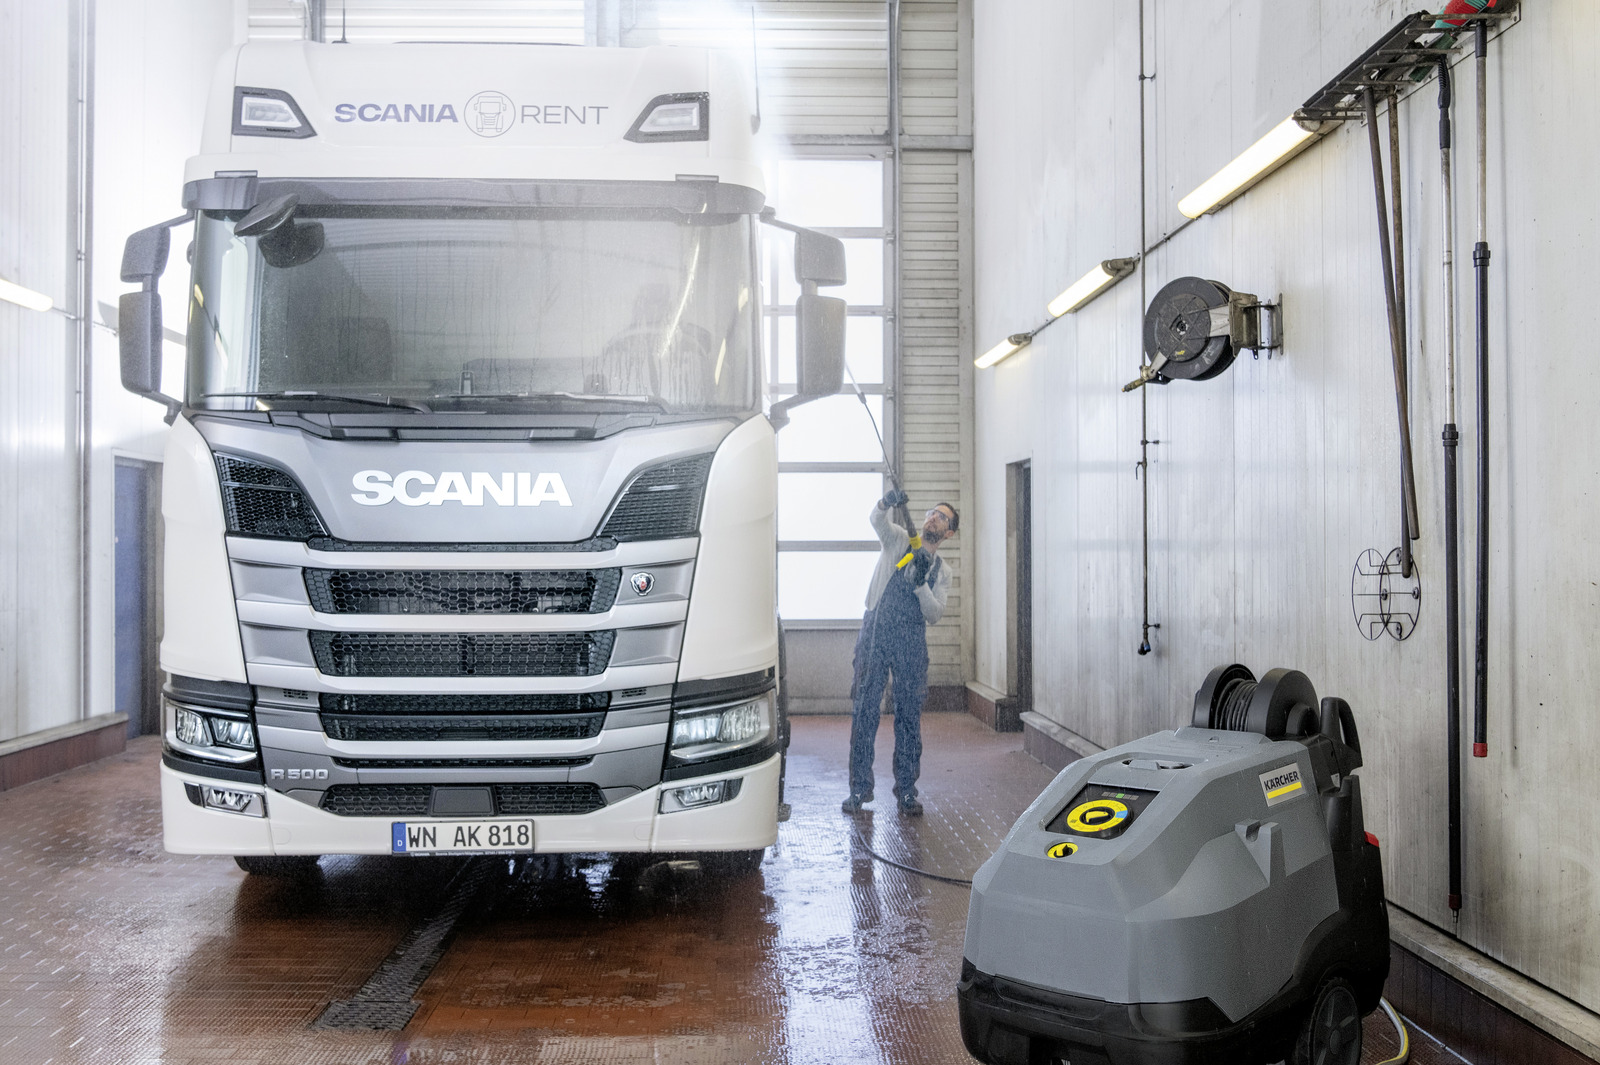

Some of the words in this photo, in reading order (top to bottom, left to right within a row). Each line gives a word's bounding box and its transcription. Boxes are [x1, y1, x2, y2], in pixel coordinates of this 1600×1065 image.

[335, 103, 459, 123] SCANIA
[521, 105, 609, 125] RENT
[351, 470, 573, 507] SCANIA
[271, 769, 285, 780] R
[288, 769, 329, 780] 500
[1264, 771, 1299, 791] KÄRCHER
[408, 826, 436, 848] WN
[453, 826, 481, 847] AK
[488, 825, 530, 847] 818
